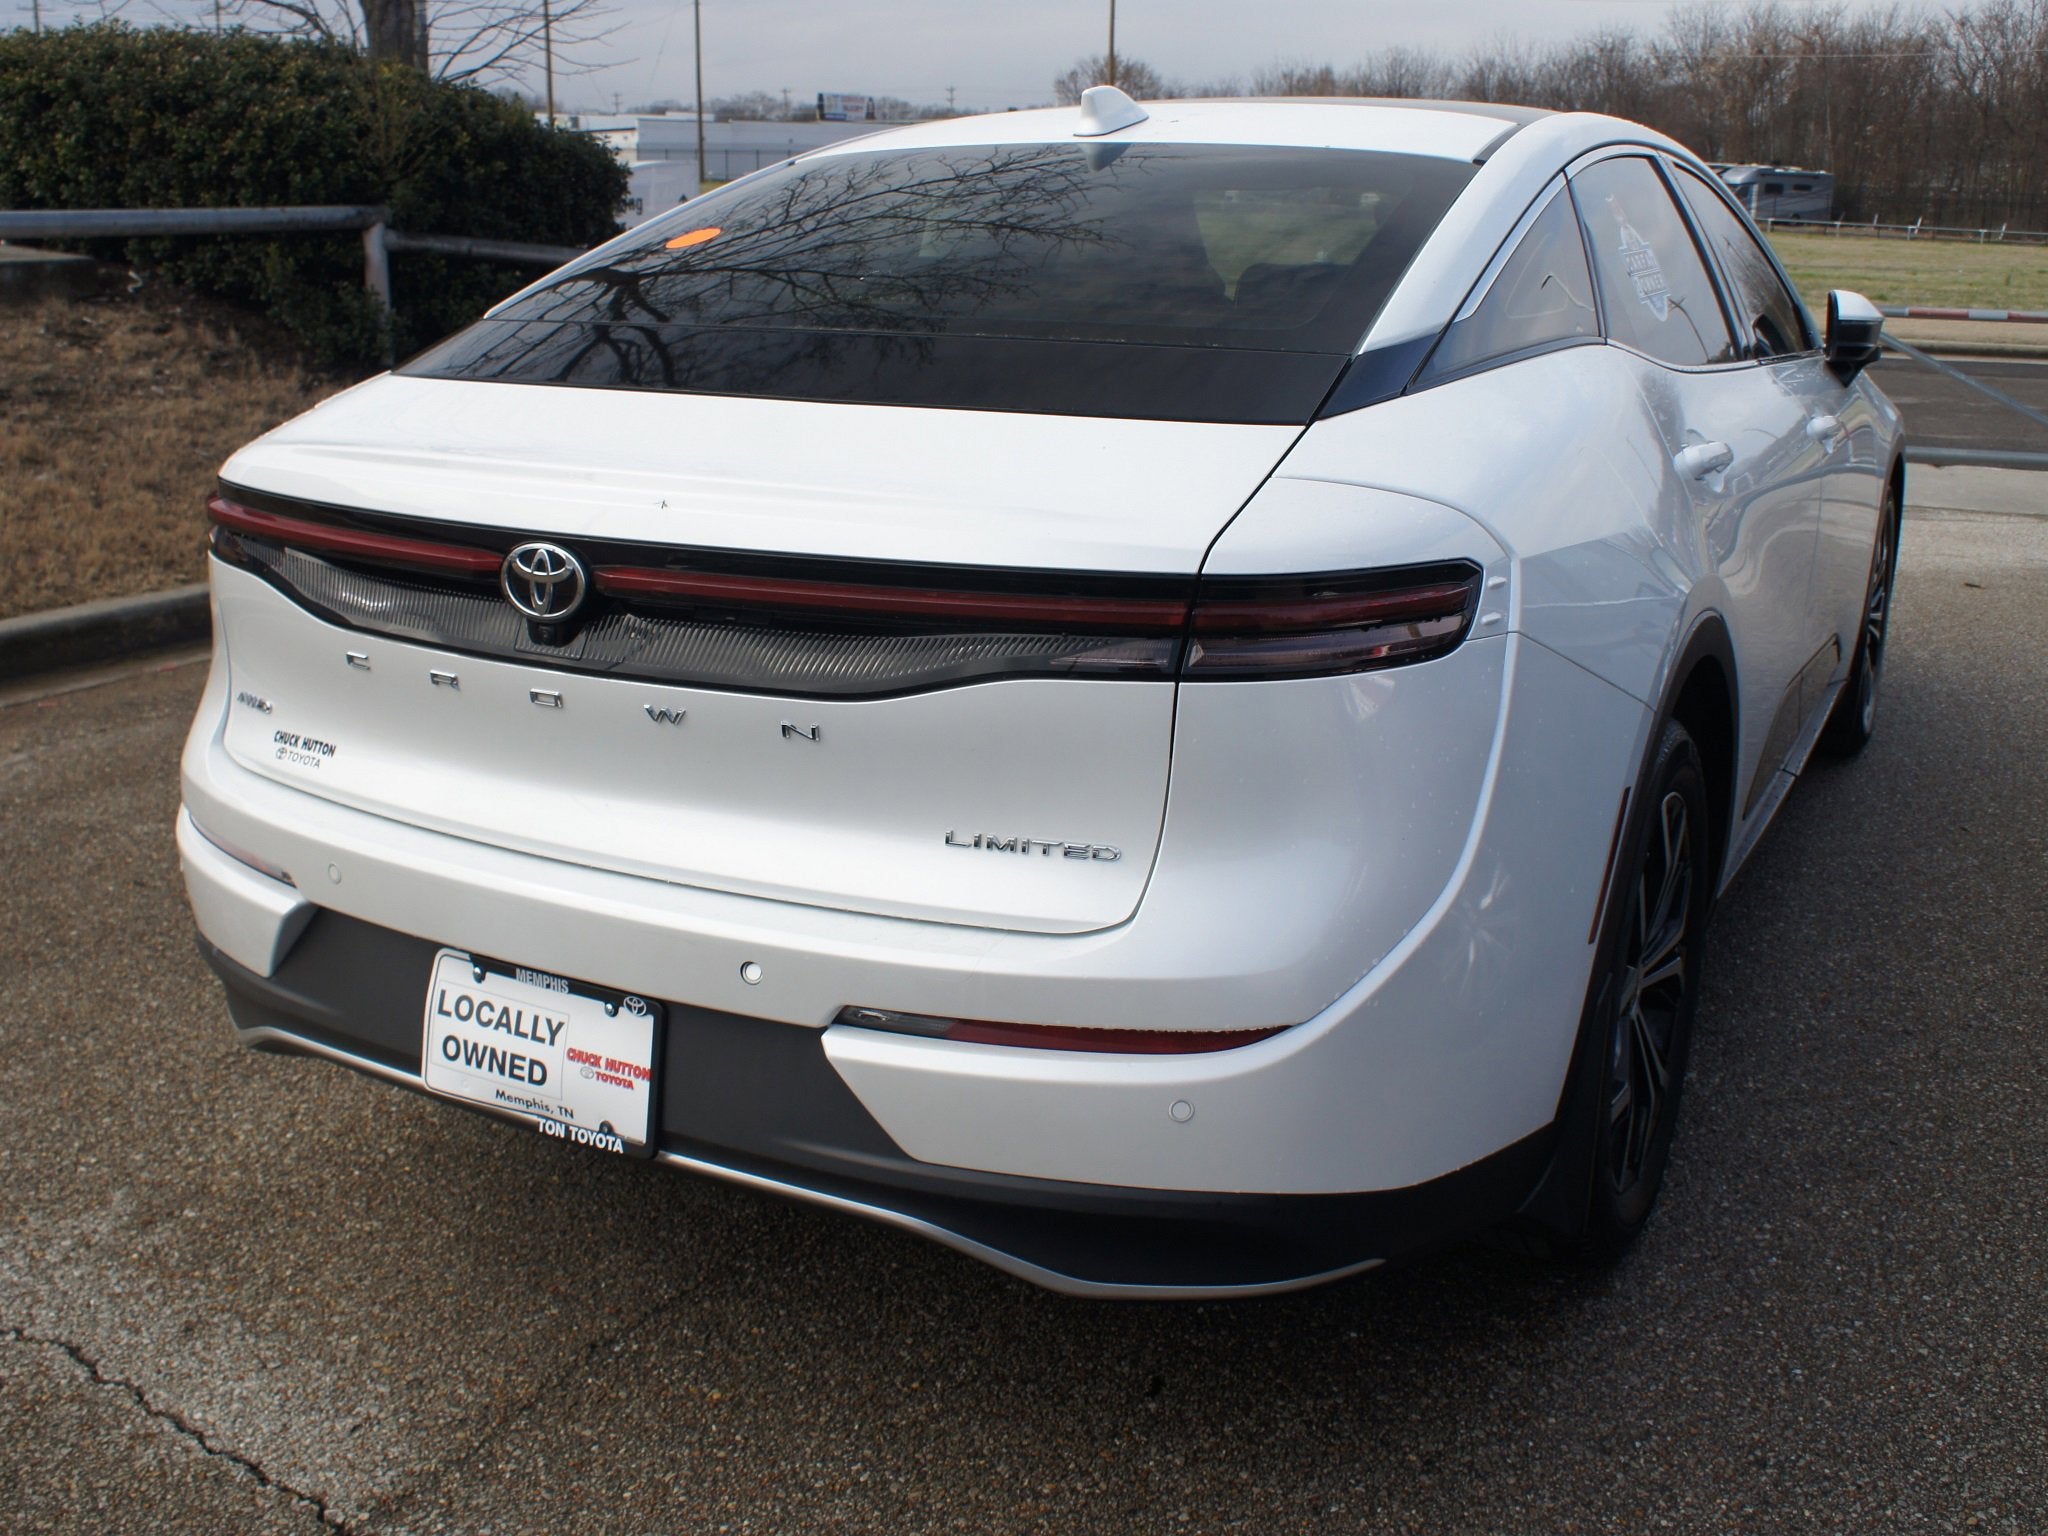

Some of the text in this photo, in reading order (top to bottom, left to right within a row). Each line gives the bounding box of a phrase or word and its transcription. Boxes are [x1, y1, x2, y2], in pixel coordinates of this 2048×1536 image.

[346, 651, 820, 742] CROWN
[274, 730, 336, 758] CHUCK HUTTON
[288, 751, 320, 768] TOYOTA
[945, 830, 1122, 862] LIMITED
[515, 968, 569, 994] MEMPHIS
[437, 989, 565, 1047] LOCALLY
[442, 1035, 548, 1087] OWNED
[567, 1048, 653, 1082] CHUCK HUTTON
[595, 1071, 634, 1090] TOYOTA
[495, 1088, 574, 1119] Memphis, TN
[569, 1126, 624, 1154] TOYOTA
